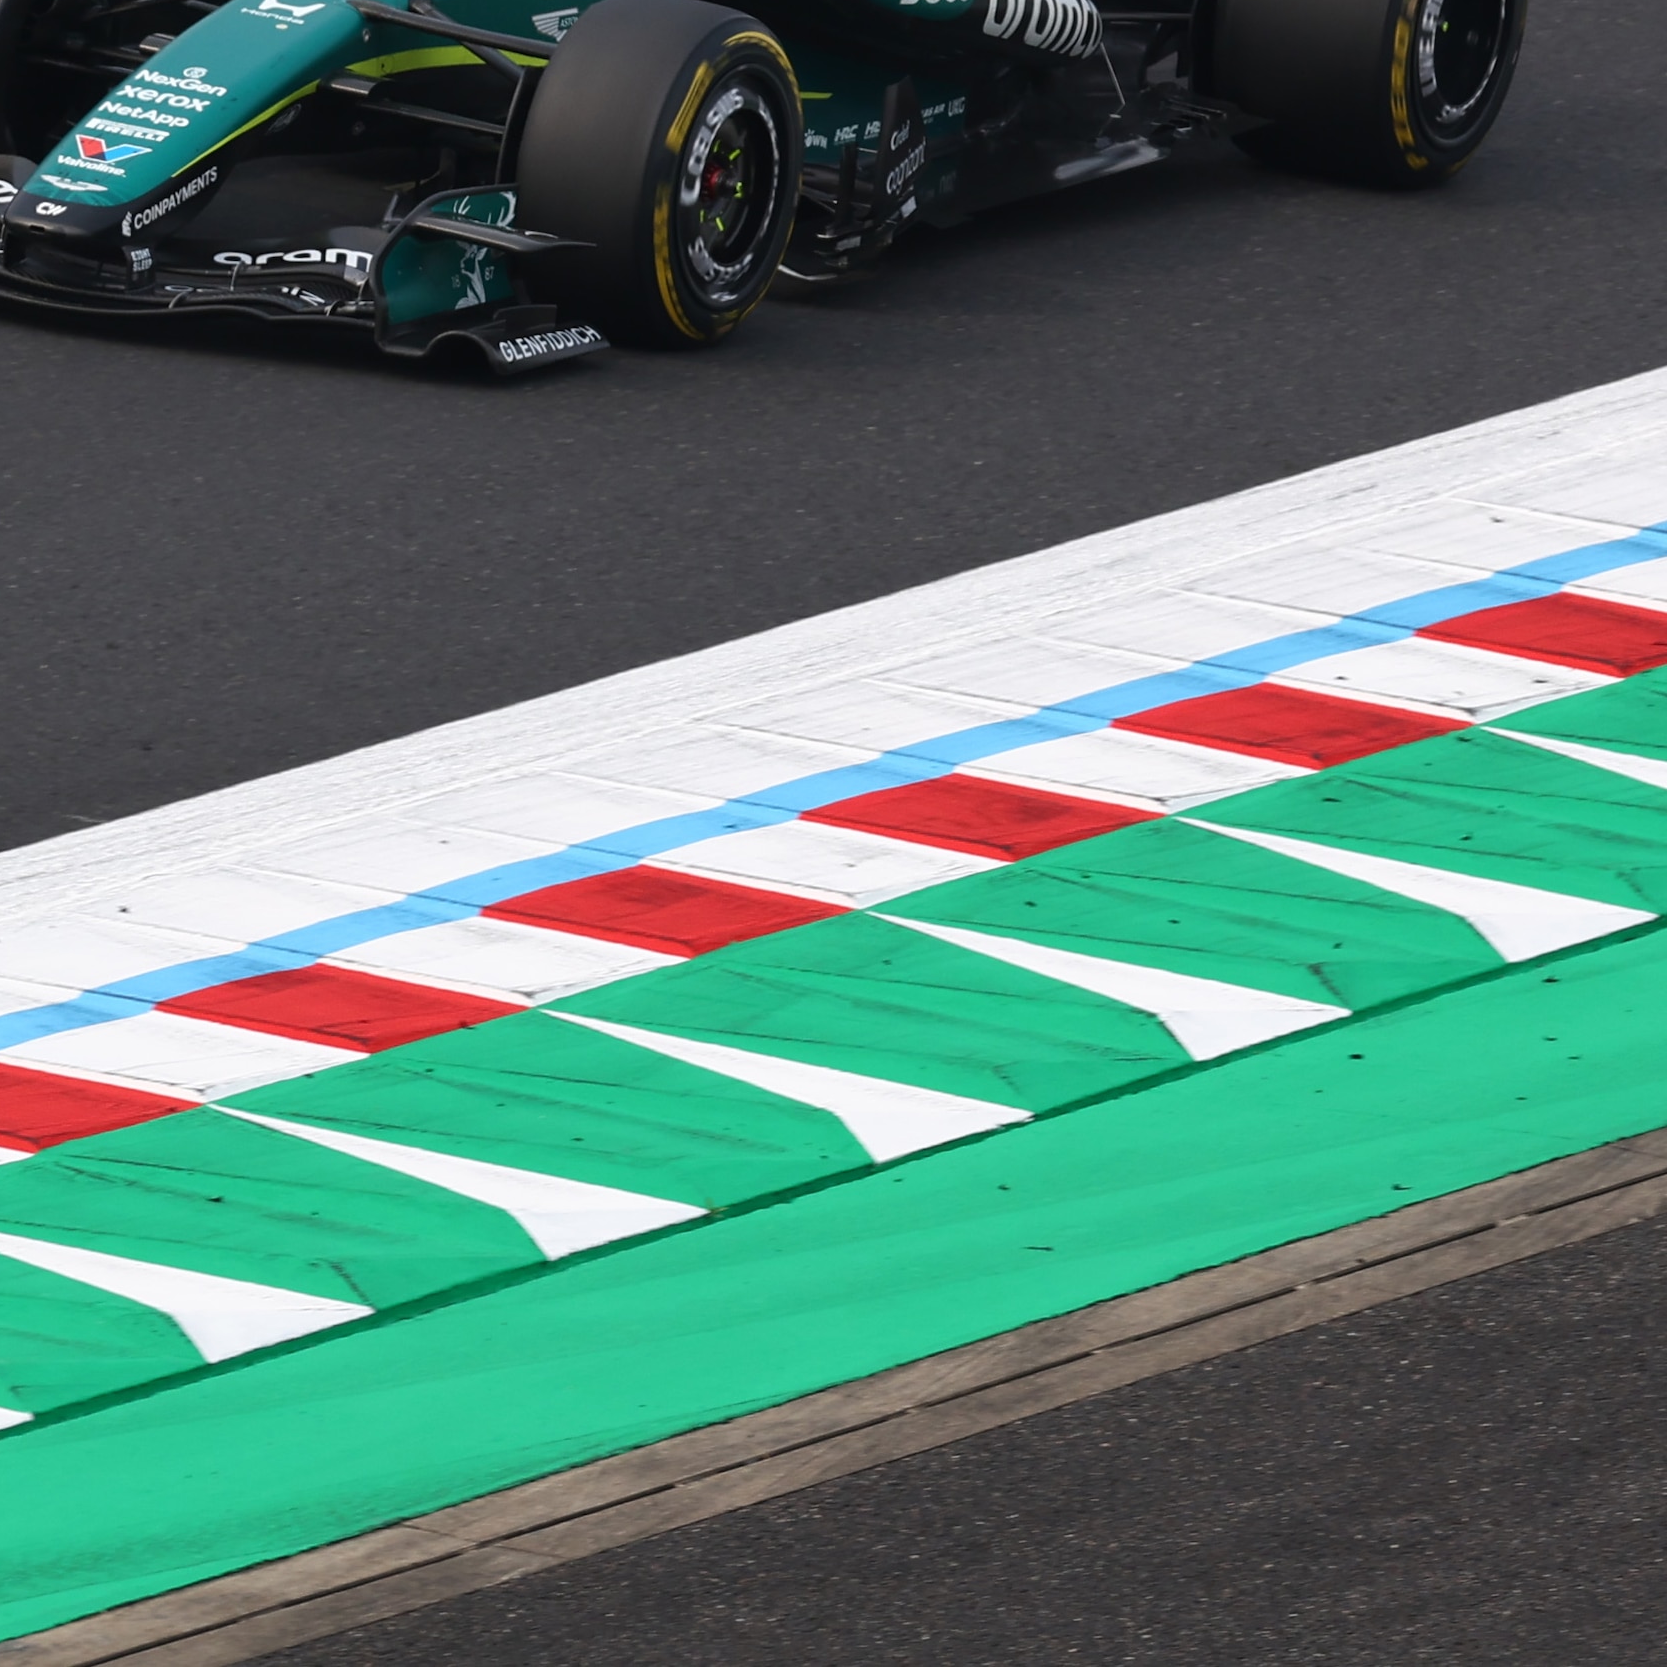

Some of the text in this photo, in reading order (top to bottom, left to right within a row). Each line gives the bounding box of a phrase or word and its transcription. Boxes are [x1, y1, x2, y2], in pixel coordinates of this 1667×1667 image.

[134, 69, 227, 97] NexGen
[116, 84, 211, 113] xerox
[98, 101, 190, 128] NetApp
[84, 117, 171, 142] PIRELLI
[134, 166, 218, 230] COINPAYMENTS
[499, 325, 602, 363] GLENFIDDICH
